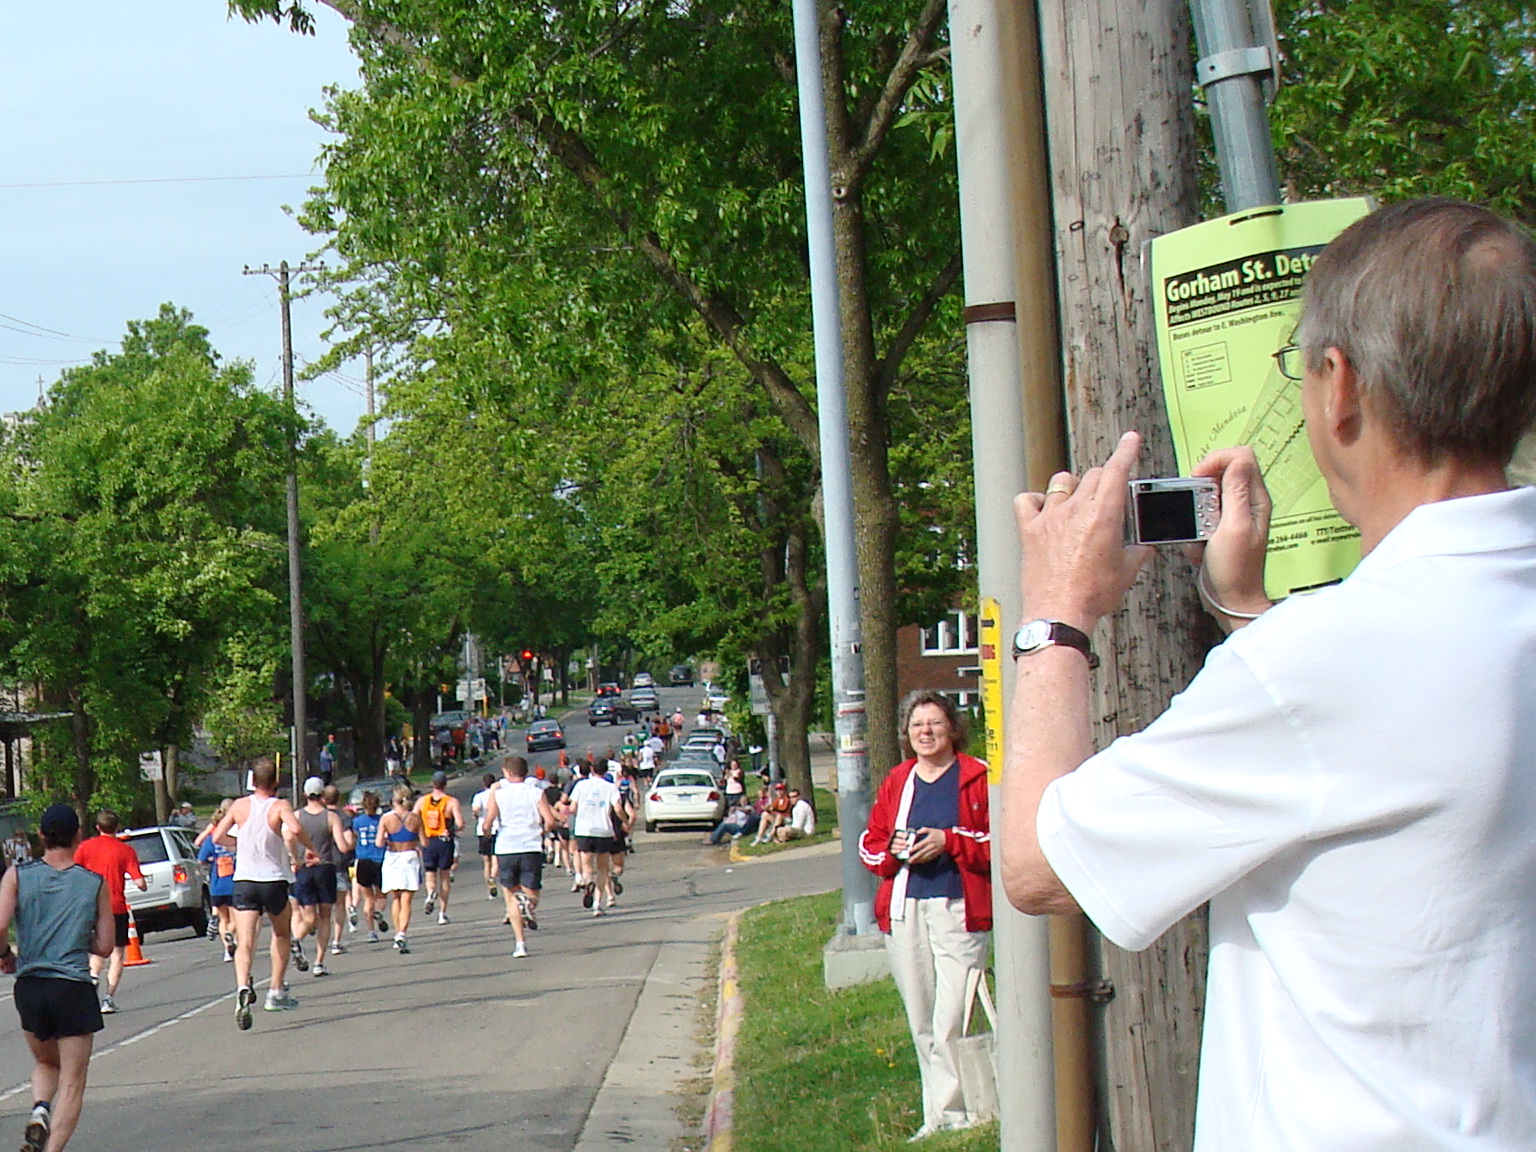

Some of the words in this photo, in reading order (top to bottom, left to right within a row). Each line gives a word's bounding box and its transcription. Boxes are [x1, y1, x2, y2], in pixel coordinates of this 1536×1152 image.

[1167, 269, 1239, 302] Gorham
[1242, 259, 1272, 284] St.
[1241, 284, 1254, 296] and
[1228, 311, 1268, 325] Washington
